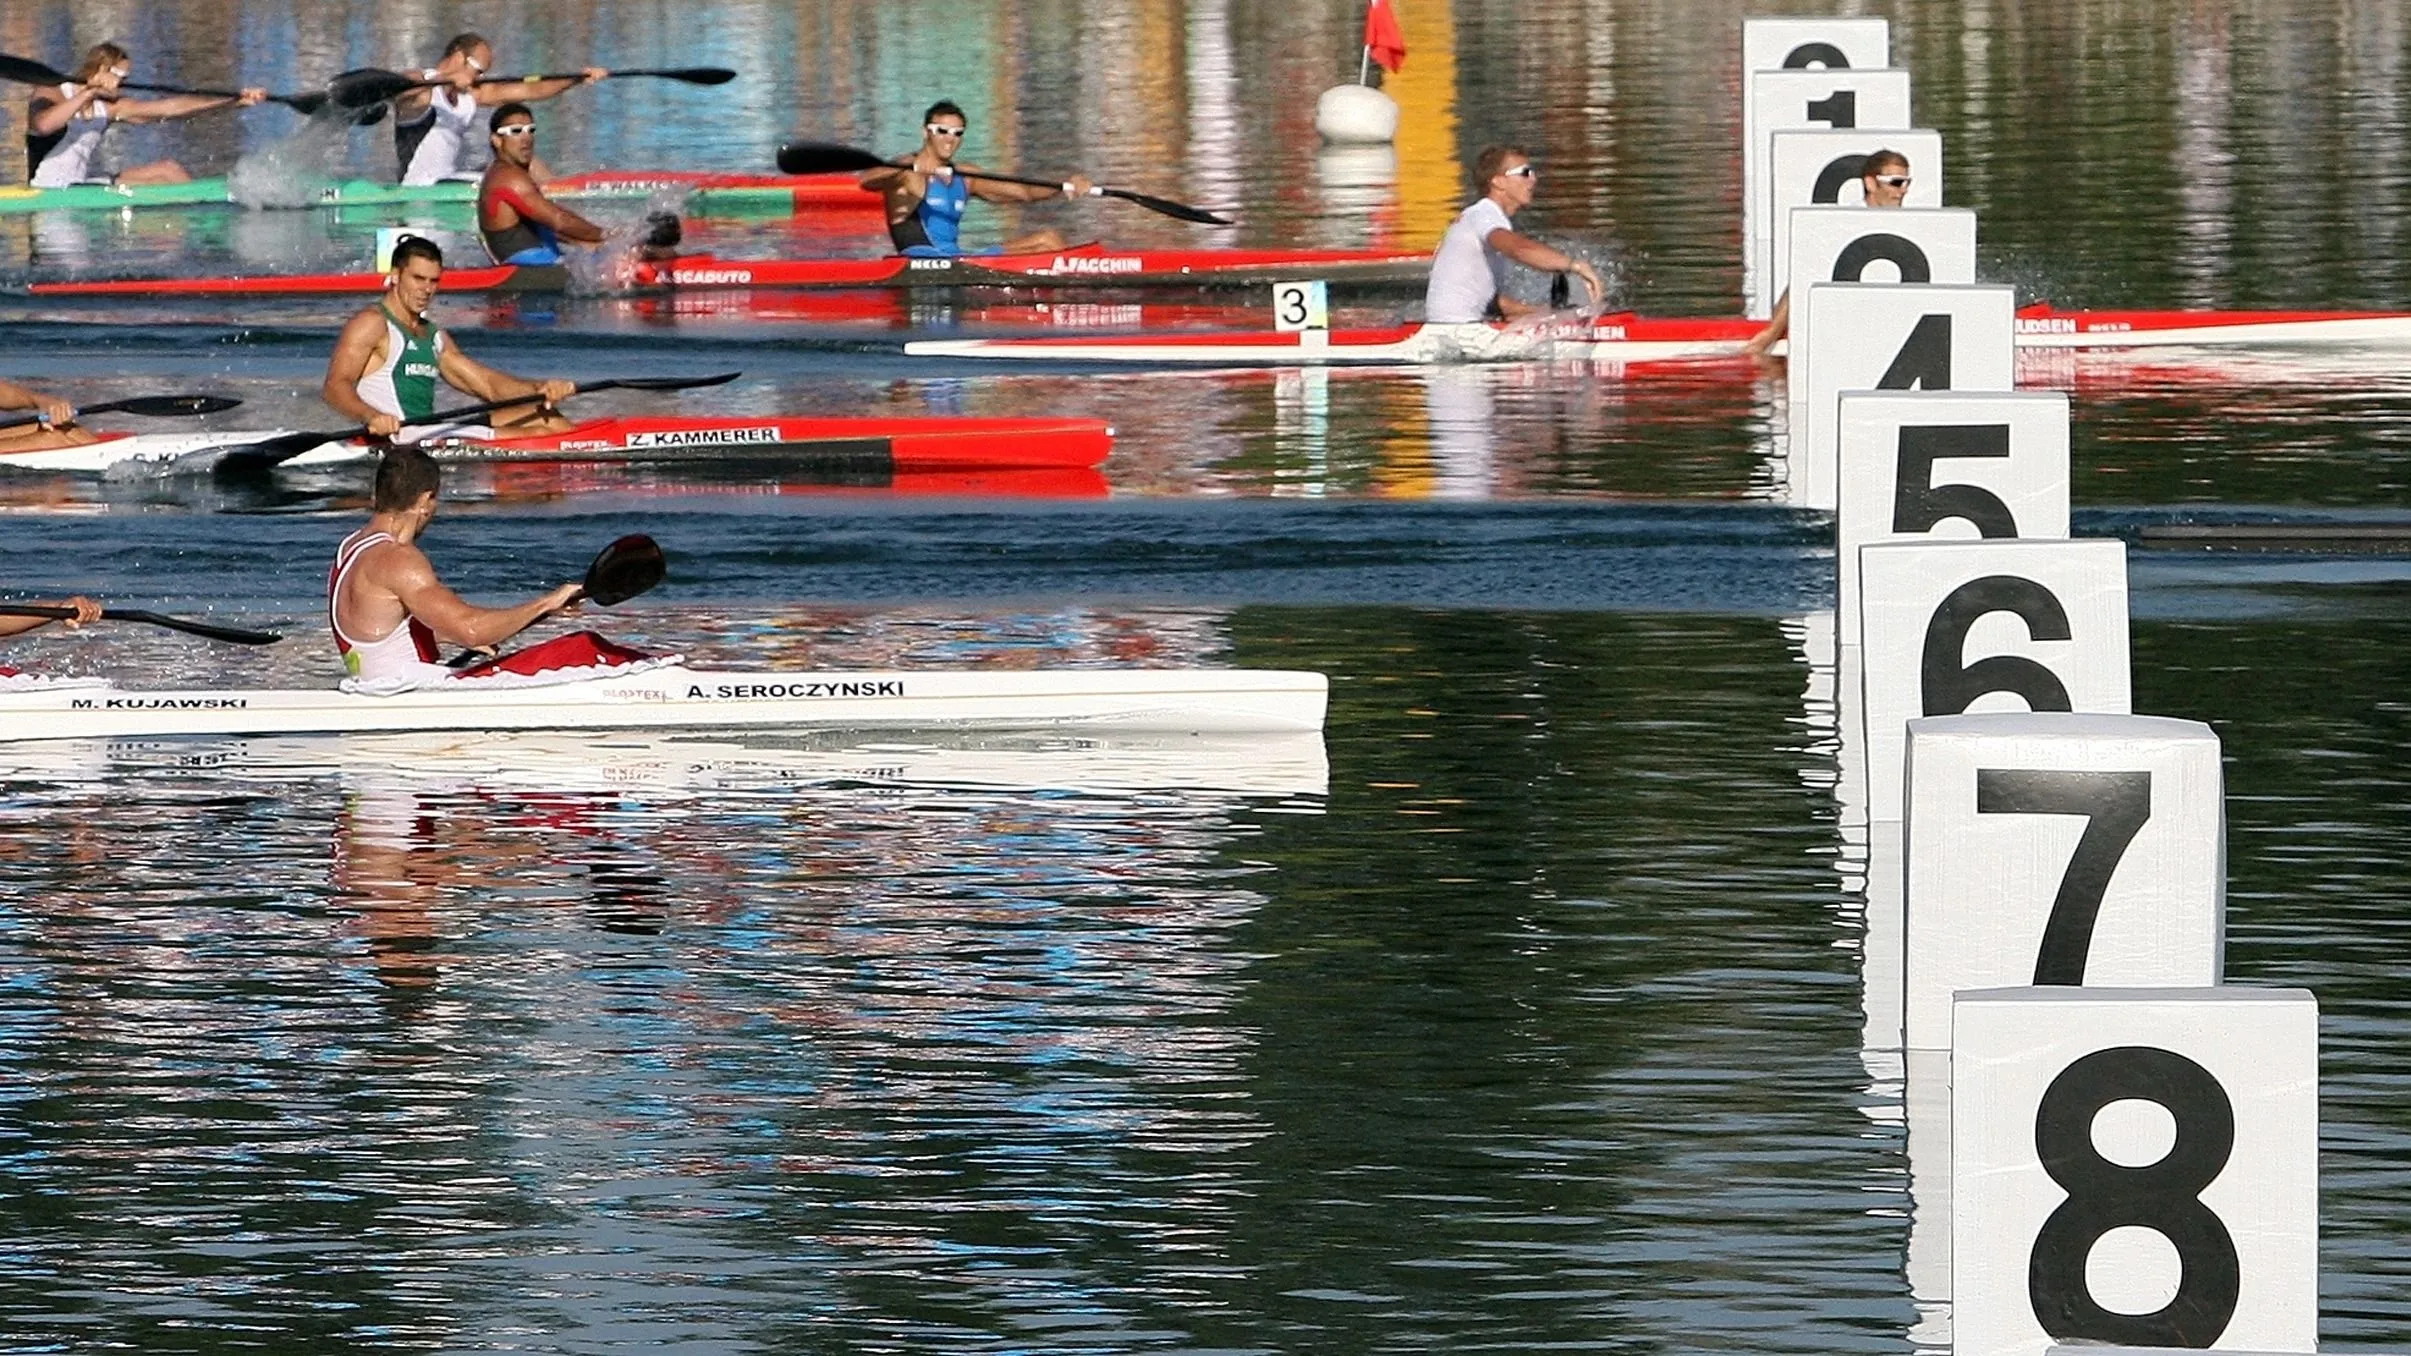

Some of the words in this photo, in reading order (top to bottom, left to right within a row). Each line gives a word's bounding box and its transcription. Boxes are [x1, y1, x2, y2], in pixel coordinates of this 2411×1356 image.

[910, 259, 952, 270] NELO
[1282, 288, 1307, 324] 3
[655, 429, 775, 444] KAMMERER
[1893, 424, 2018, 538] 5
[1921, 574, 2073, 718] 6
[72, 699, 99, 708] M.
[105, 699, 248, 709] KUJAWSKI
[687, 685, 711, 698] A.
[716, 681, 905, 698] SEROCZYNSKI
[1977, 768, 2152, 986] 7
[2029, 1045, 2240, 1349] 8
